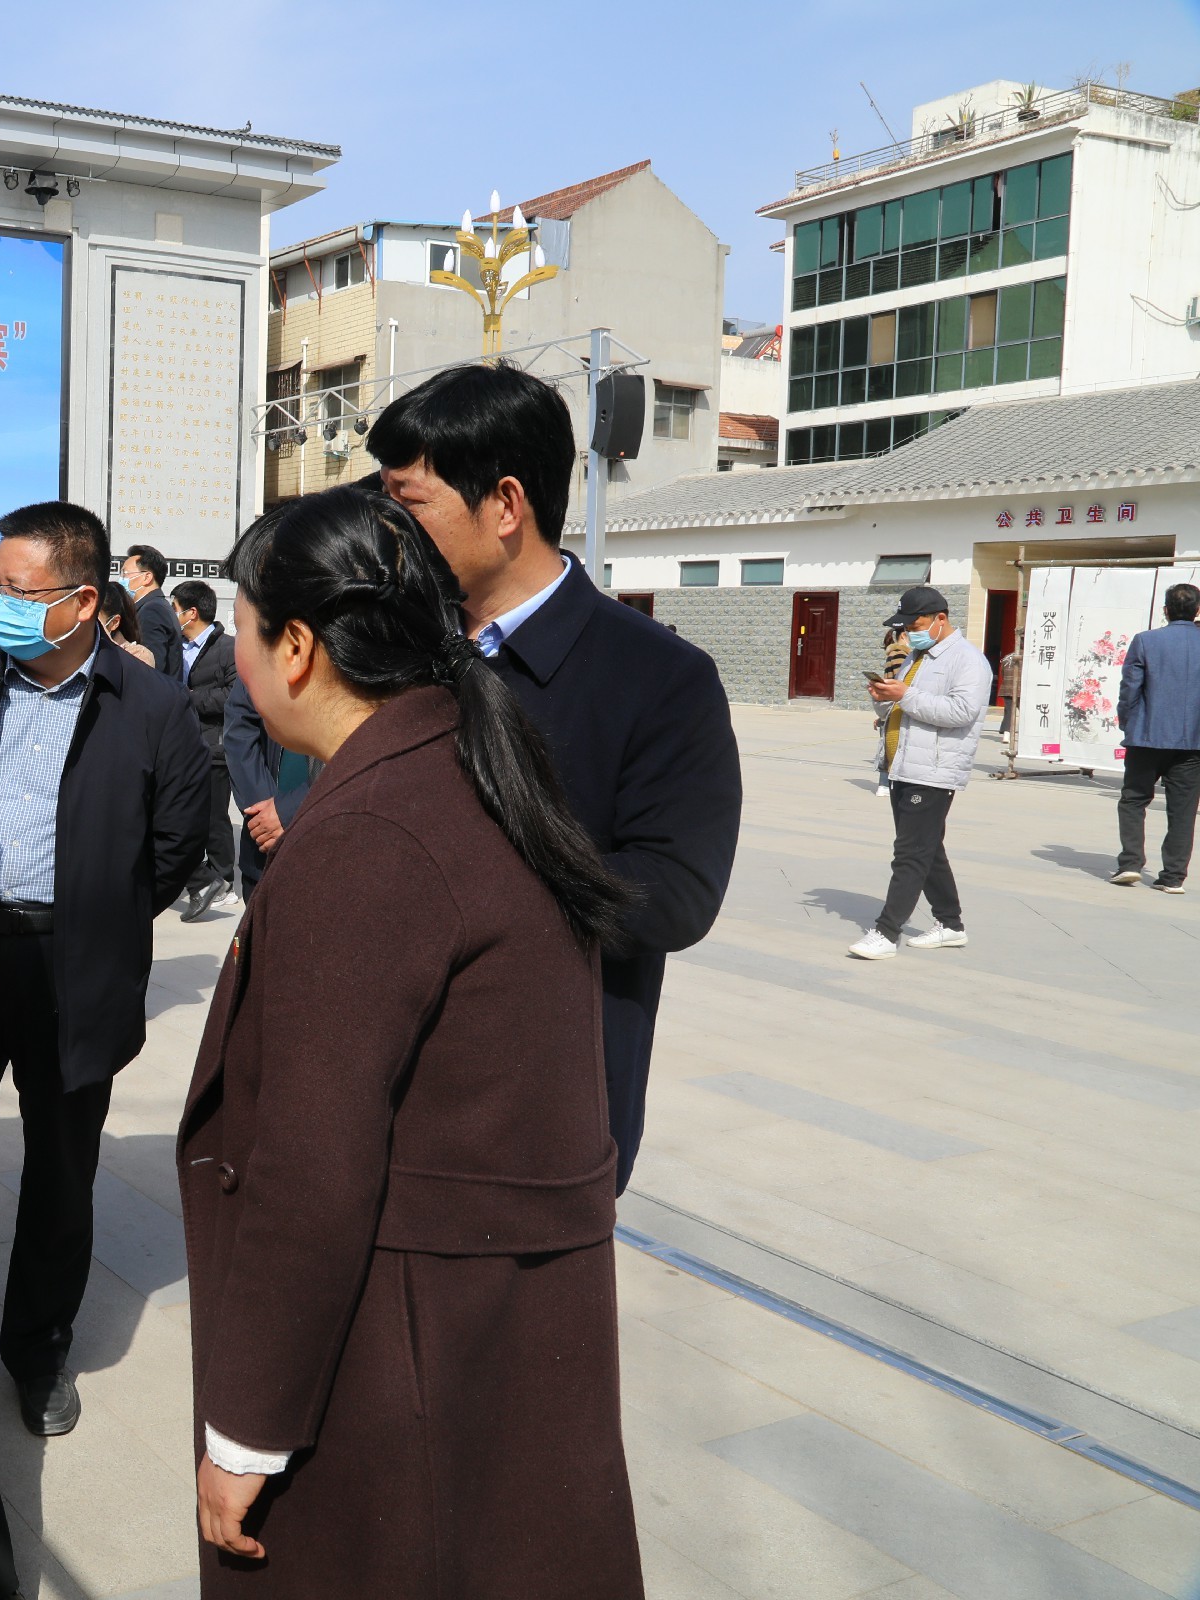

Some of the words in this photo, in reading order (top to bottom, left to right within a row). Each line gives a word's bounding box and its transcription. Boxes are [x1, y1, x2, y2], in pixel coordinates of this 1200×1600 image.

[996, 503, 1137, 528] 公共卫生间
